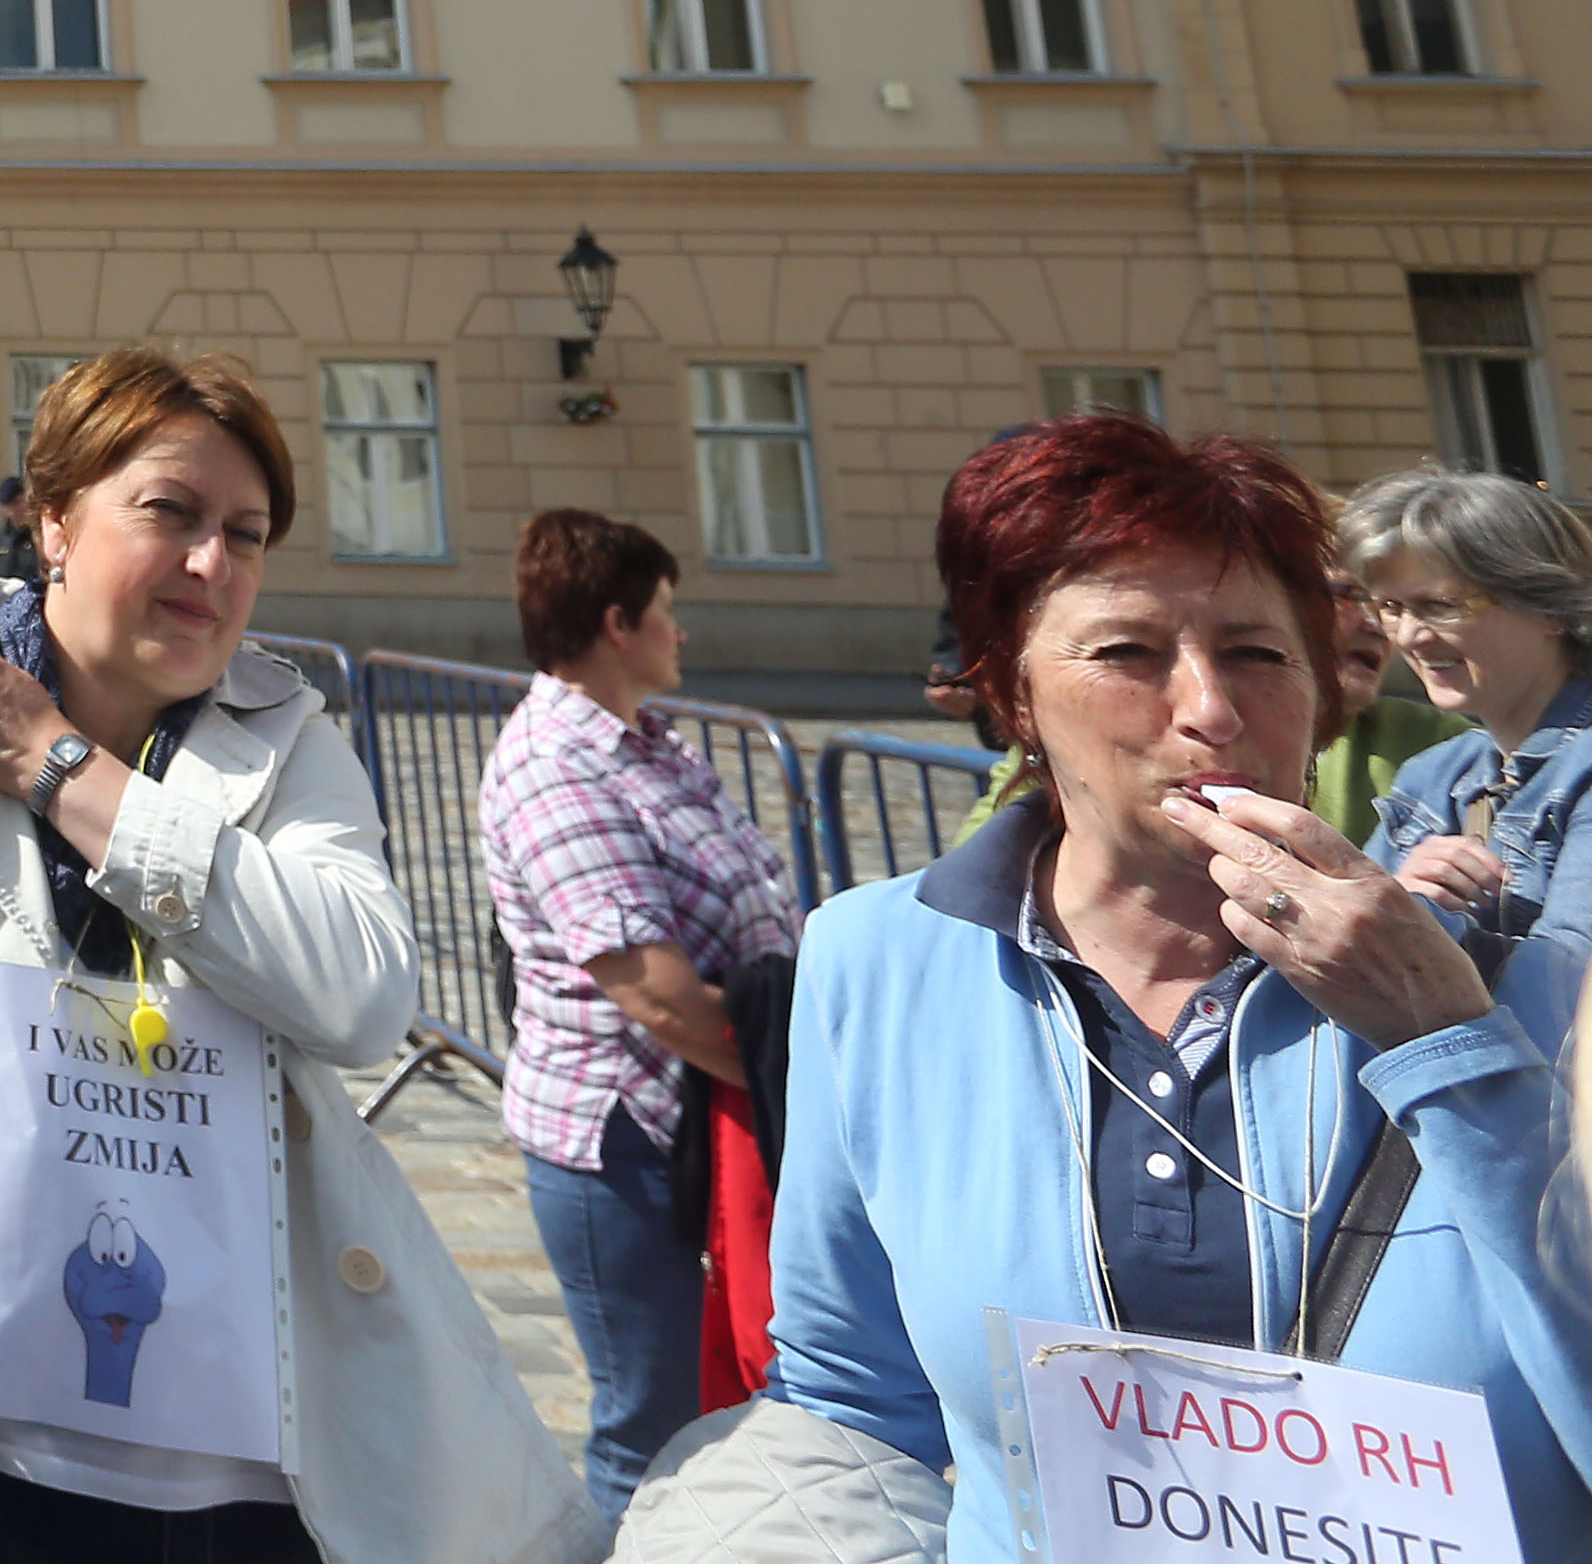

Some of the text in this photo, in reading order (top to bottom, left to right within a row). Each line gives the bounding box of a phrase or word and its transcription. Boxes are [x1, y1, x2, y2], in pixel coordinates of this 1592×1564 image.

[28, 1024, 40, 1052] I
[52, 1028, 108, 1064] VAS
[46, 1073, 211, 1126] UGRISTI
[64, 1129, 193, 1178] ZMIJA
[1079, 1374, 1455, 1497] VLADO RH
